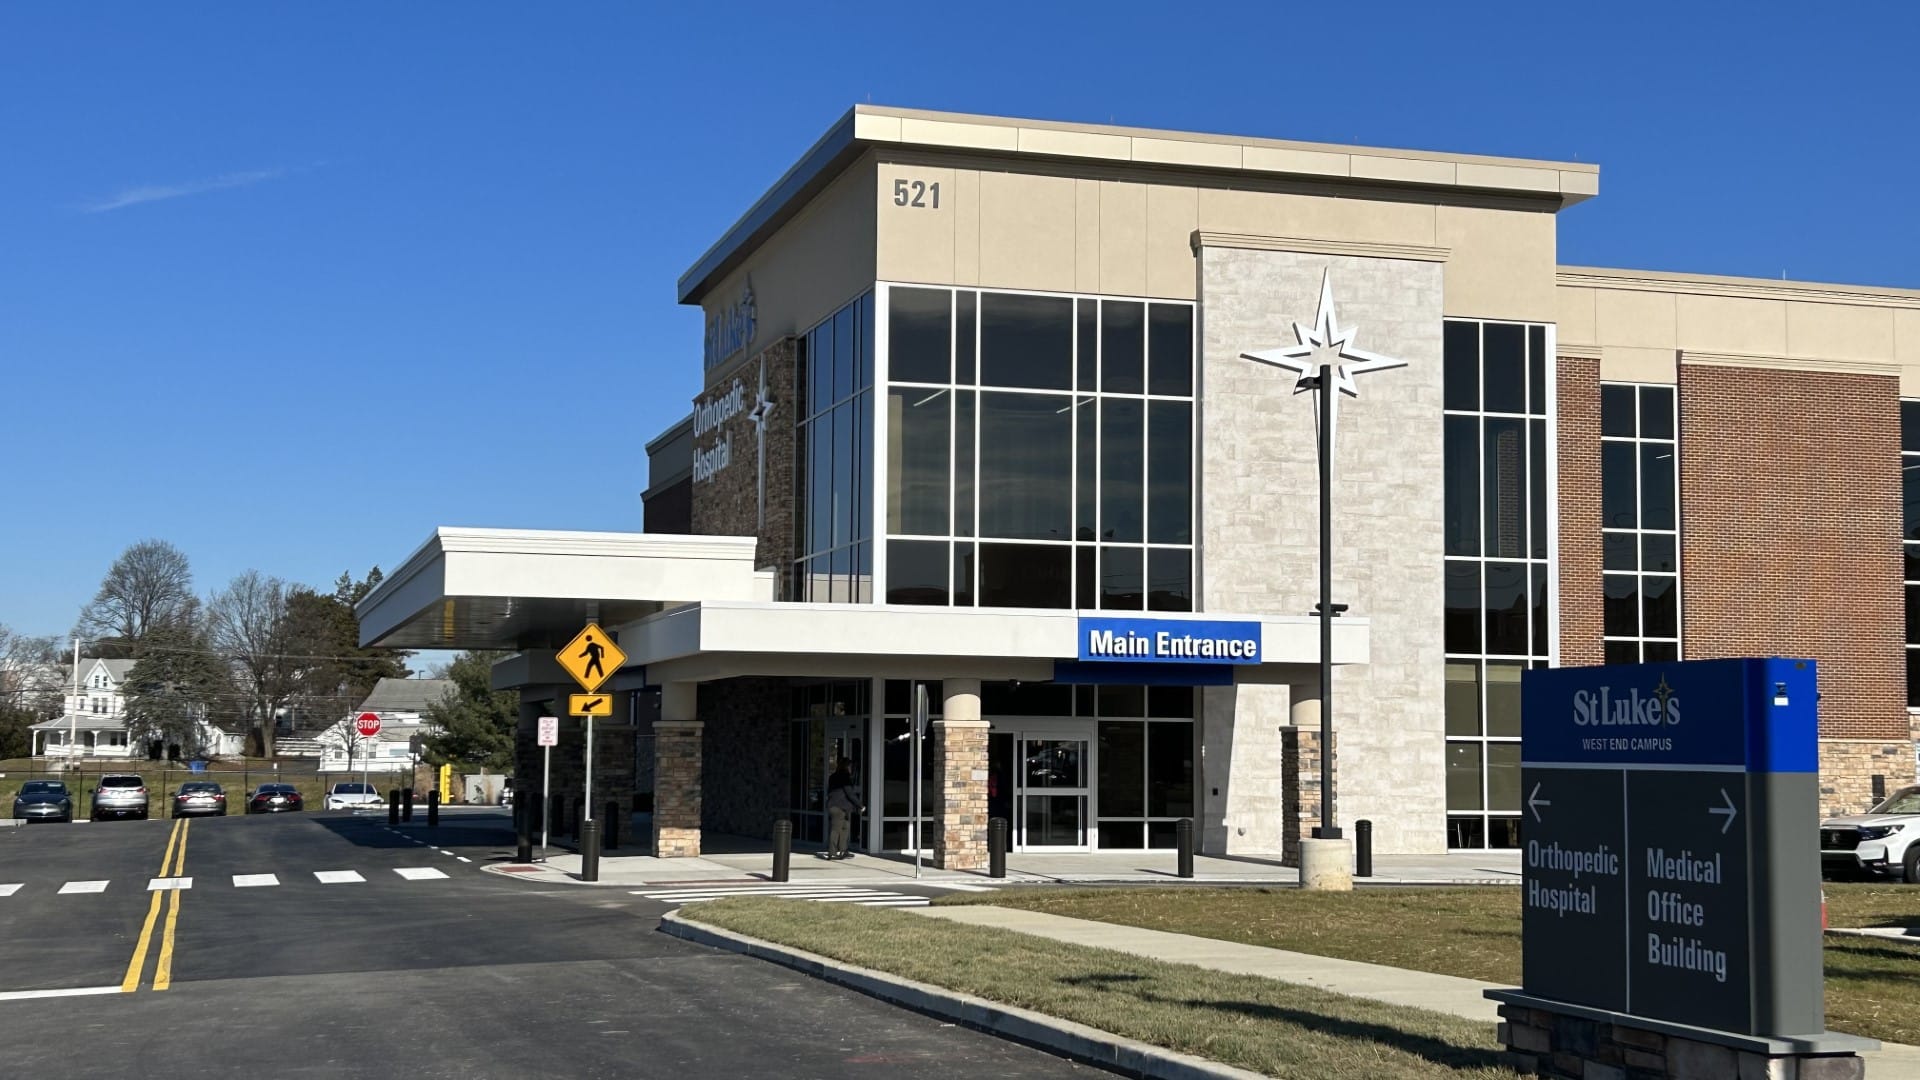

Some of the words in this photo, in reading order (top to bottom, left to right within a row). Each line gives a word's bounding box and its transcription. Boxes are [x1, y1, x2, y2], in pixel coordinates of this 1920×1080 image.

[894, 178, 940, 209] 521
[694, 377, 744, 438] Orthopedic
[693, 430, 733, 484] Hospital
[1090, 629, 1149, 655] Main
[1156, 631, 1257, 659] Entrance
[358, 719, 380, 729] STOP
[1582, 738, 1608, 750] WEST
[1609, 738, 1629, 750] END
[1631, 738, 1672, 751] CAMPUS
[1528, 839, 1619, 879] Orthopedic
[1647, 847, 1721, 884] Medical
[1528, 879, 1596, 918] Hospital
[1647, 890, 1704, 927] Office
[1648, 933, 1726, 983] Building
